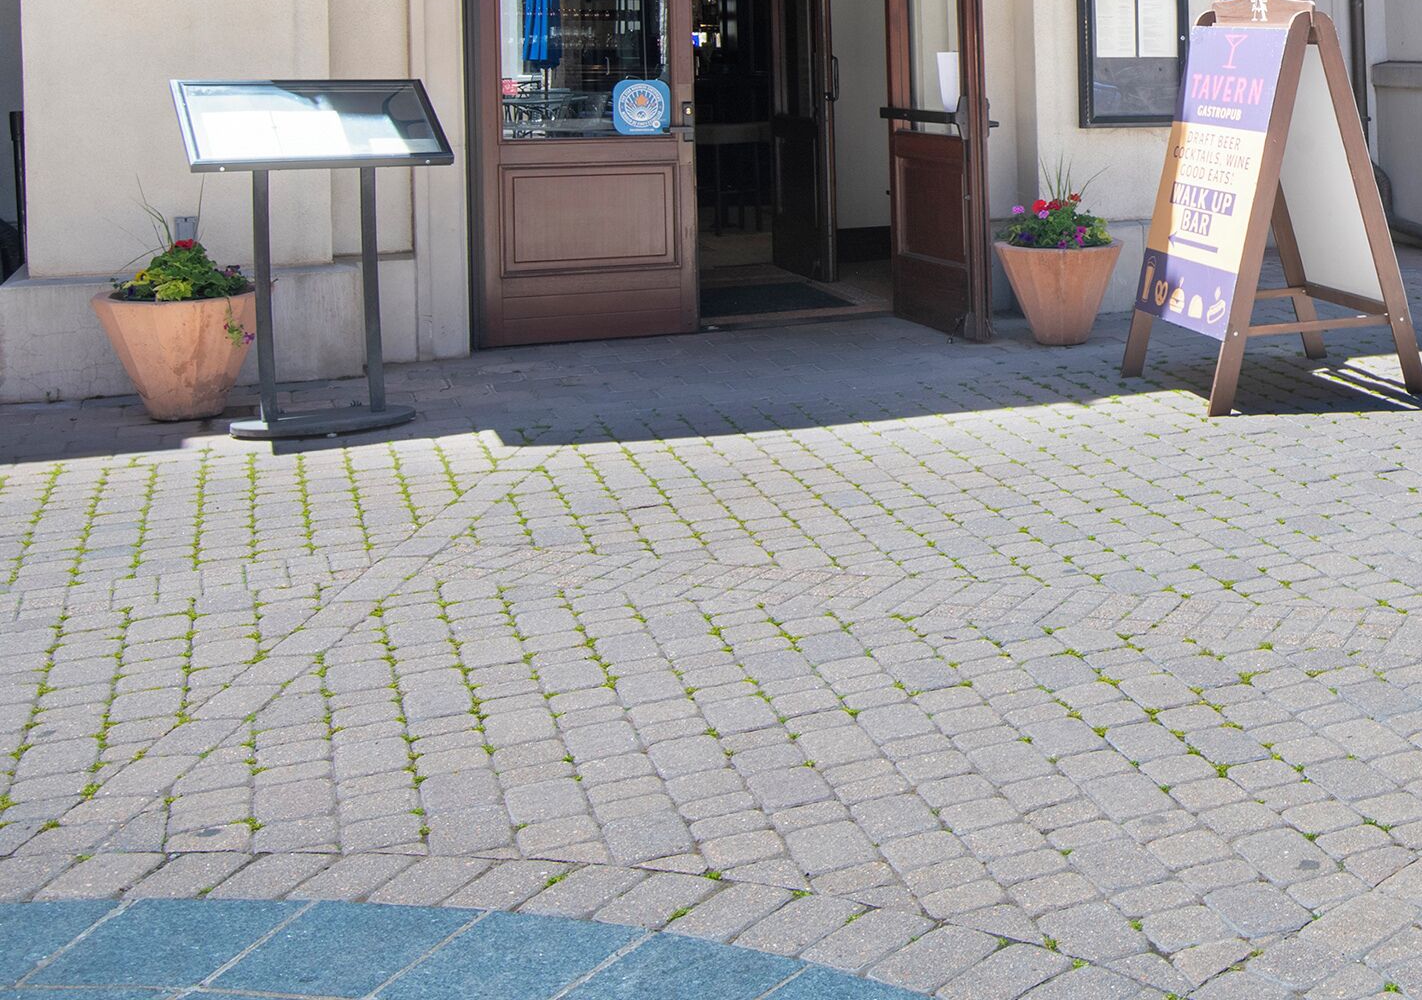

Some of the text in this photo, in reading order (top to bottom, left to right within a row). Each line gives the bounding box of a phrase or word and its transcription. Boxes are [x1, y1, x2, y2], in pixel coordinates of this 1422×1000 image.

[1191, 74, 1264, 105] TAVERN
[1197, 105, 1242, 121] GASTROPUB
[1187, 130, 1241, 151] DRAFT BEER
[1180, 163, 1205, 180] GOOD
[1226, 153, 1251, 171] WINE
[1173, 182, 1233, 215] WALK UP
[1181, 208, 1210, 236] BAR
